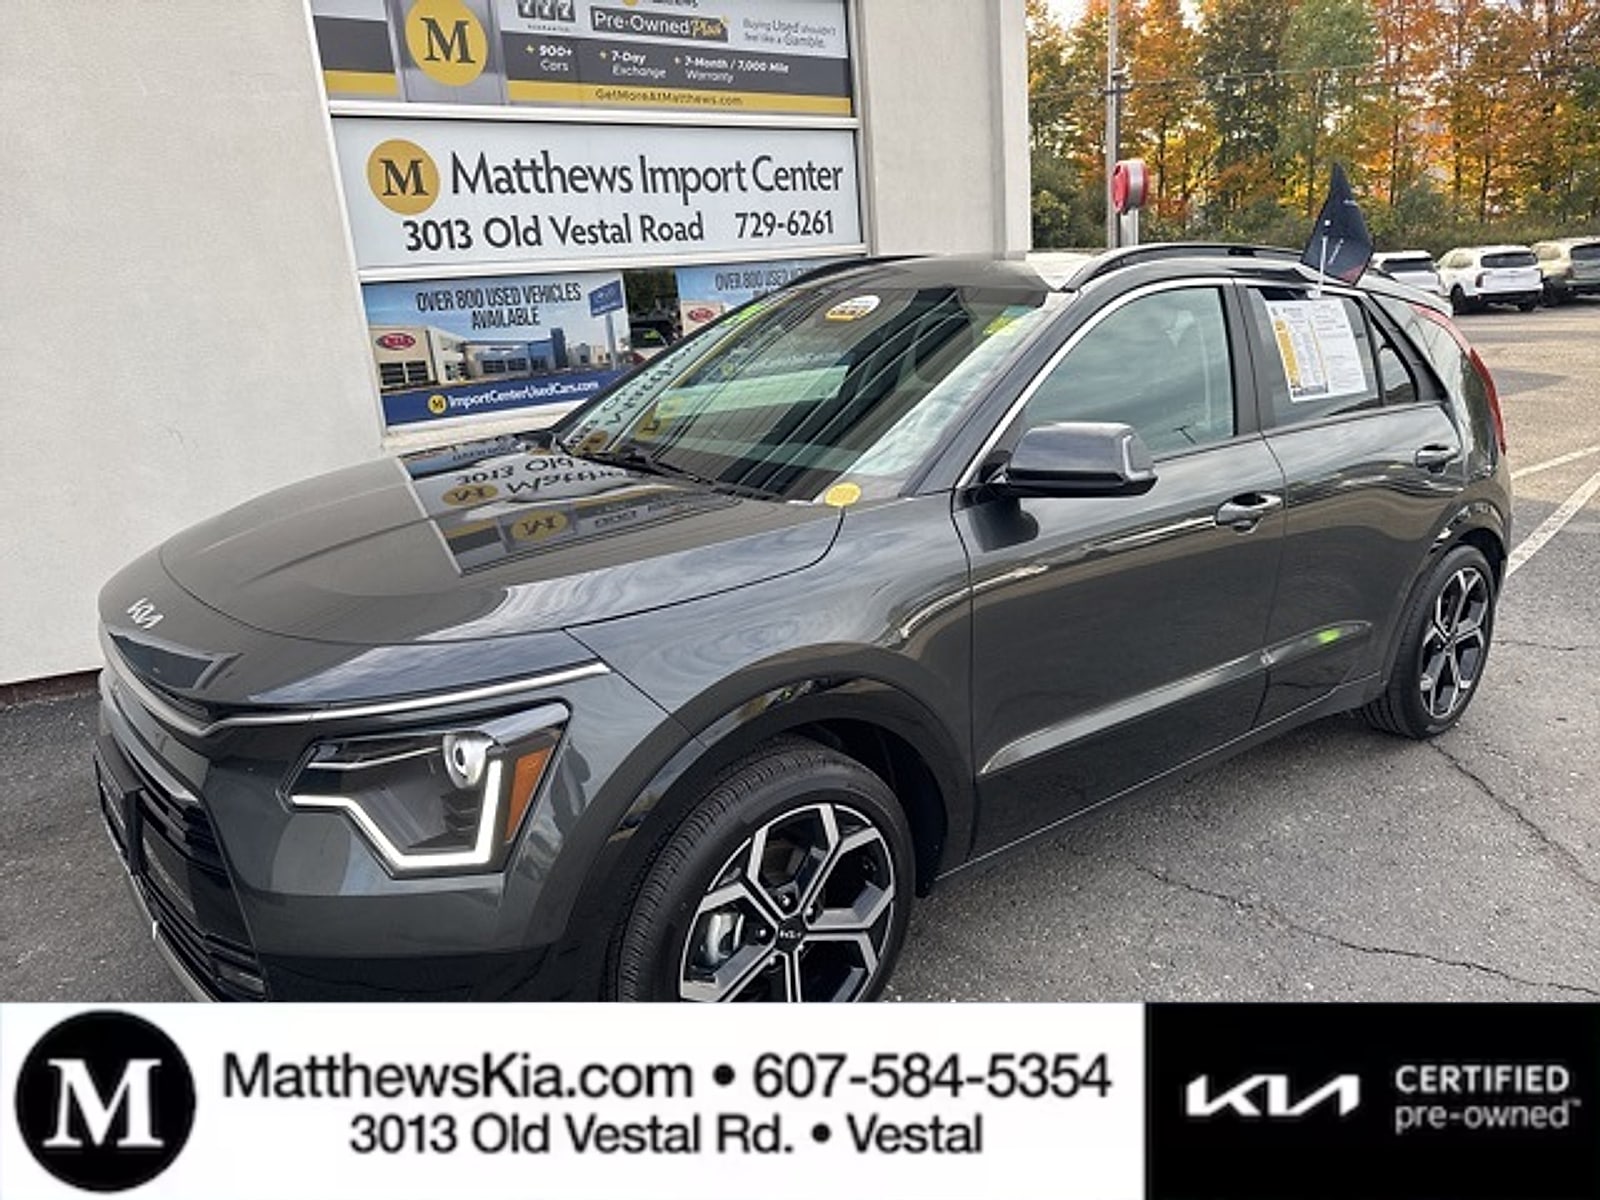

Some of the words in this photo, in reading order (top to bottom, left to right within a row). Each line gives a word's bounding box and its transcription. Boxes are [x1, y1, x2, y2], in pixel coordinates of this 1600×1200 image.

[594, 10, 690, 36] Pre-Owned
[420, 17, 476, 64] M
[541, 59, 569, 72] Cars
[611, 50, 646, 64] 7-Day
[770, 63, 789, 74] Mile
[612, 64, 666, 79] Exchange
[686, 69, 734, 84] Warranty
[595, 87, 743, 107] GetMoreAtMatthews.com
[380, 158, 428, 197] M
[451, 150, 632, 195] Matthews
[640, 154, 747, 206] Import
[752, 156, 843, 194] Center
[405, 219, 473, 252] 3013
[483, 215, 543, 248] Old
[548, 213, 632, 245] Vestal
[641, 211, 704, 242] Road
[735, 210, 834, 239] 729-6261
[715, 271, 741, 291] OVER
[416, 290, 454, 312] OVER
[455, 287, 485, 309] 800
[486, 285, 521, 306] USED
[522, 282, 582, 304] VEHICLES
[471, 306, 541, 330] AVAILABLE
[447, 381, 599, 410] ImportCenterUsedCars.com
[127, 598, 164, 629] KIA
